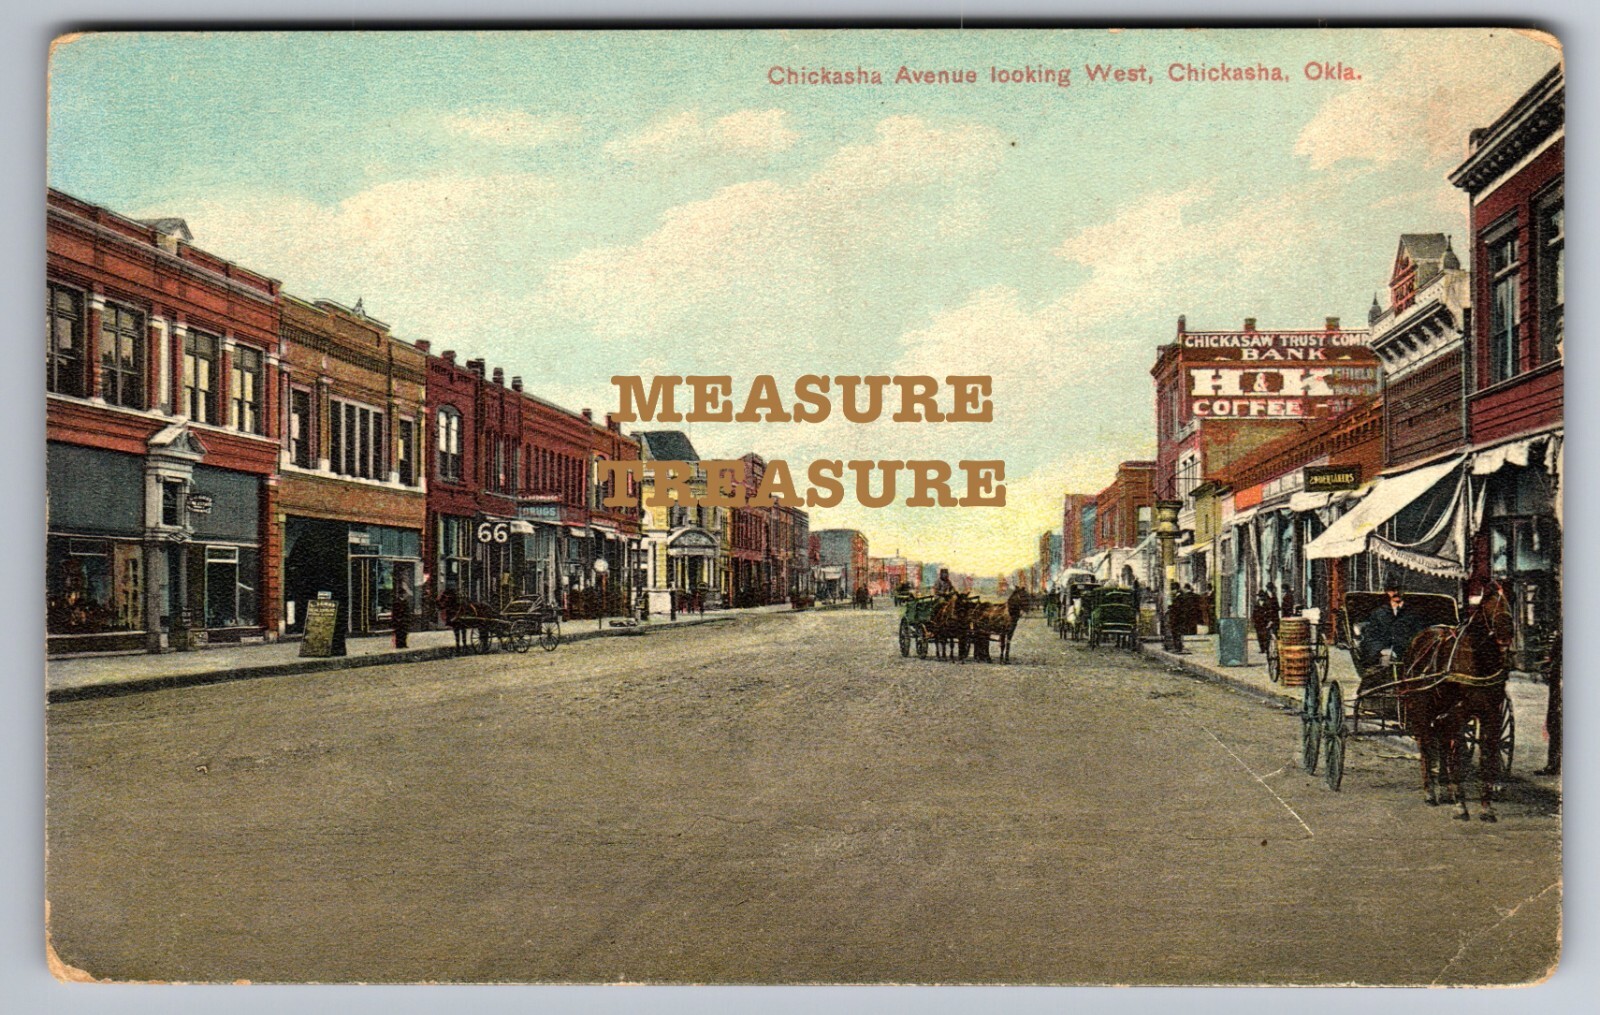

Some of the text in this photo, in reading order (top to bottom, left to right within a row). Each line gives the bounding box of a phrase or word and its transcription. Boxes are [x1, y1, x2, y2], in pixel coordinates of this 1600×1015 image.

[1184, 334, 1274, 348] CHICKASAW
[1279, 334, 1327, 347] TRUST
[1241, 347, 1327, 361] BANK
[522, 506, 556, 517] DRUGS
[477, 522, 509, 544] 66
